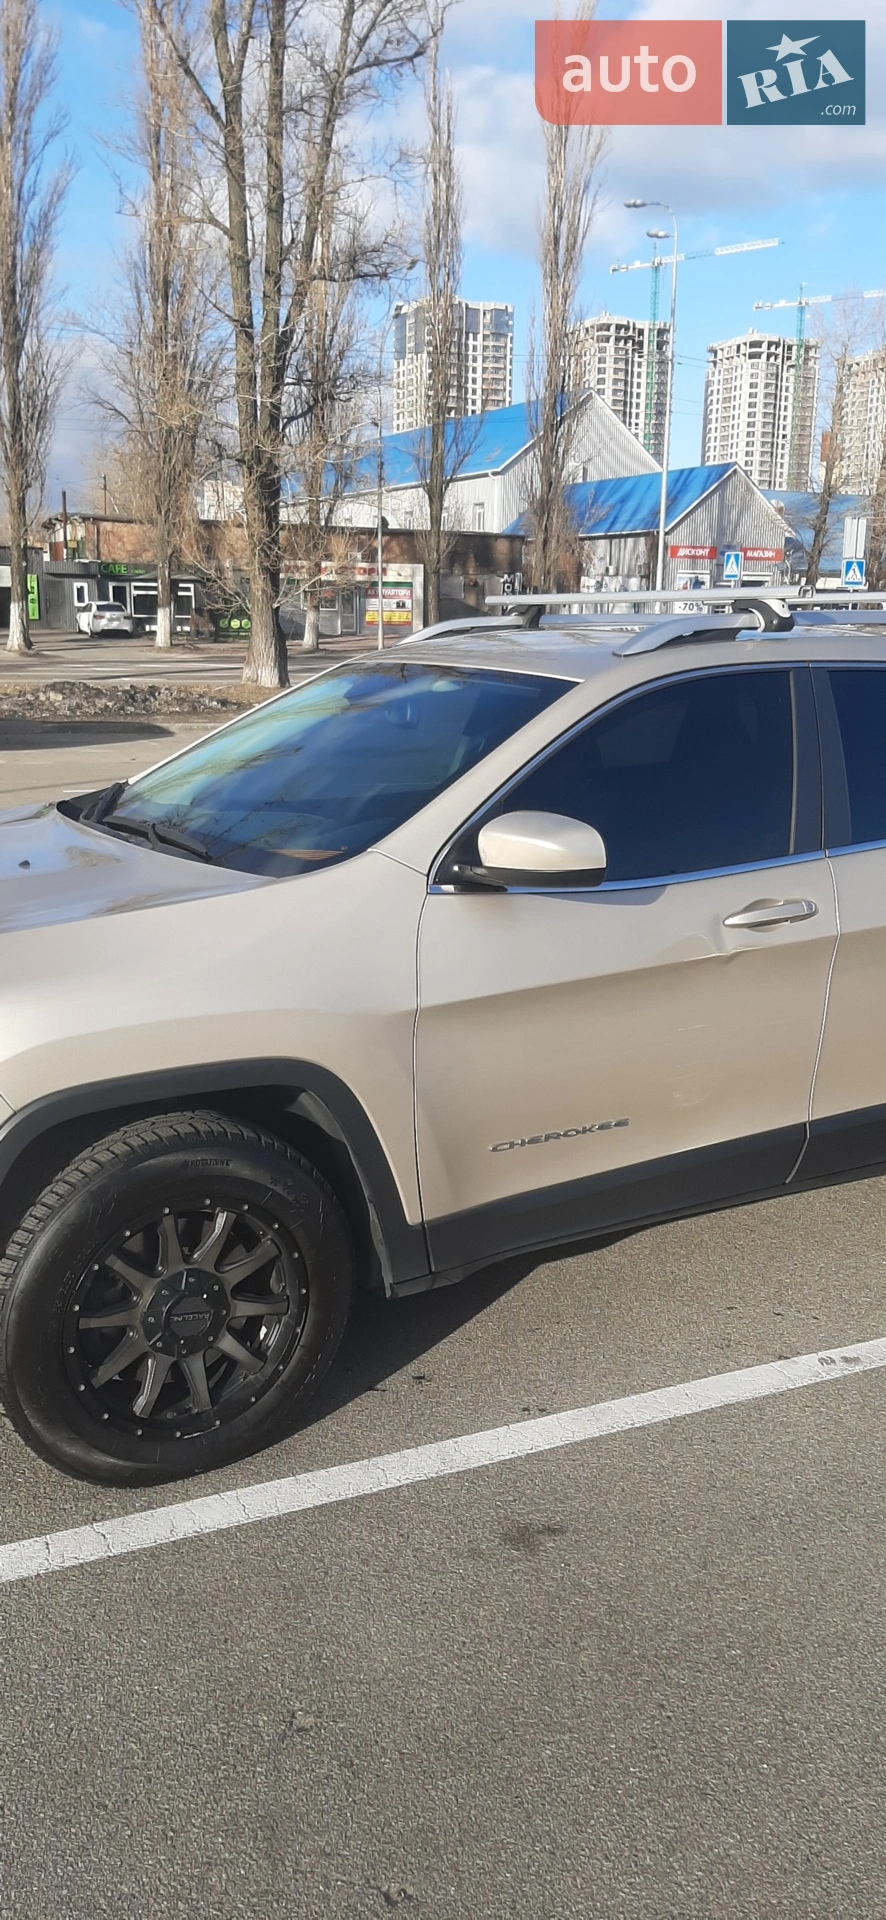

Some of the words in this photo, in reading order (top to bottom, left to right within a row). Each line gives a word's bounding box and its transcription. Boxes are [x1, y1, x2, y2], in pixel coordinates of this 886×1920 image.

[678, 548, 710, 557] ДИСКОНТ
[747, 550, 775, 558] МАГАЗИН
[101, 564, 127, 574] CAFE
[678, 602, 703, 612] -70%
[489, 1118, 630, 1152] CHEROKEE
